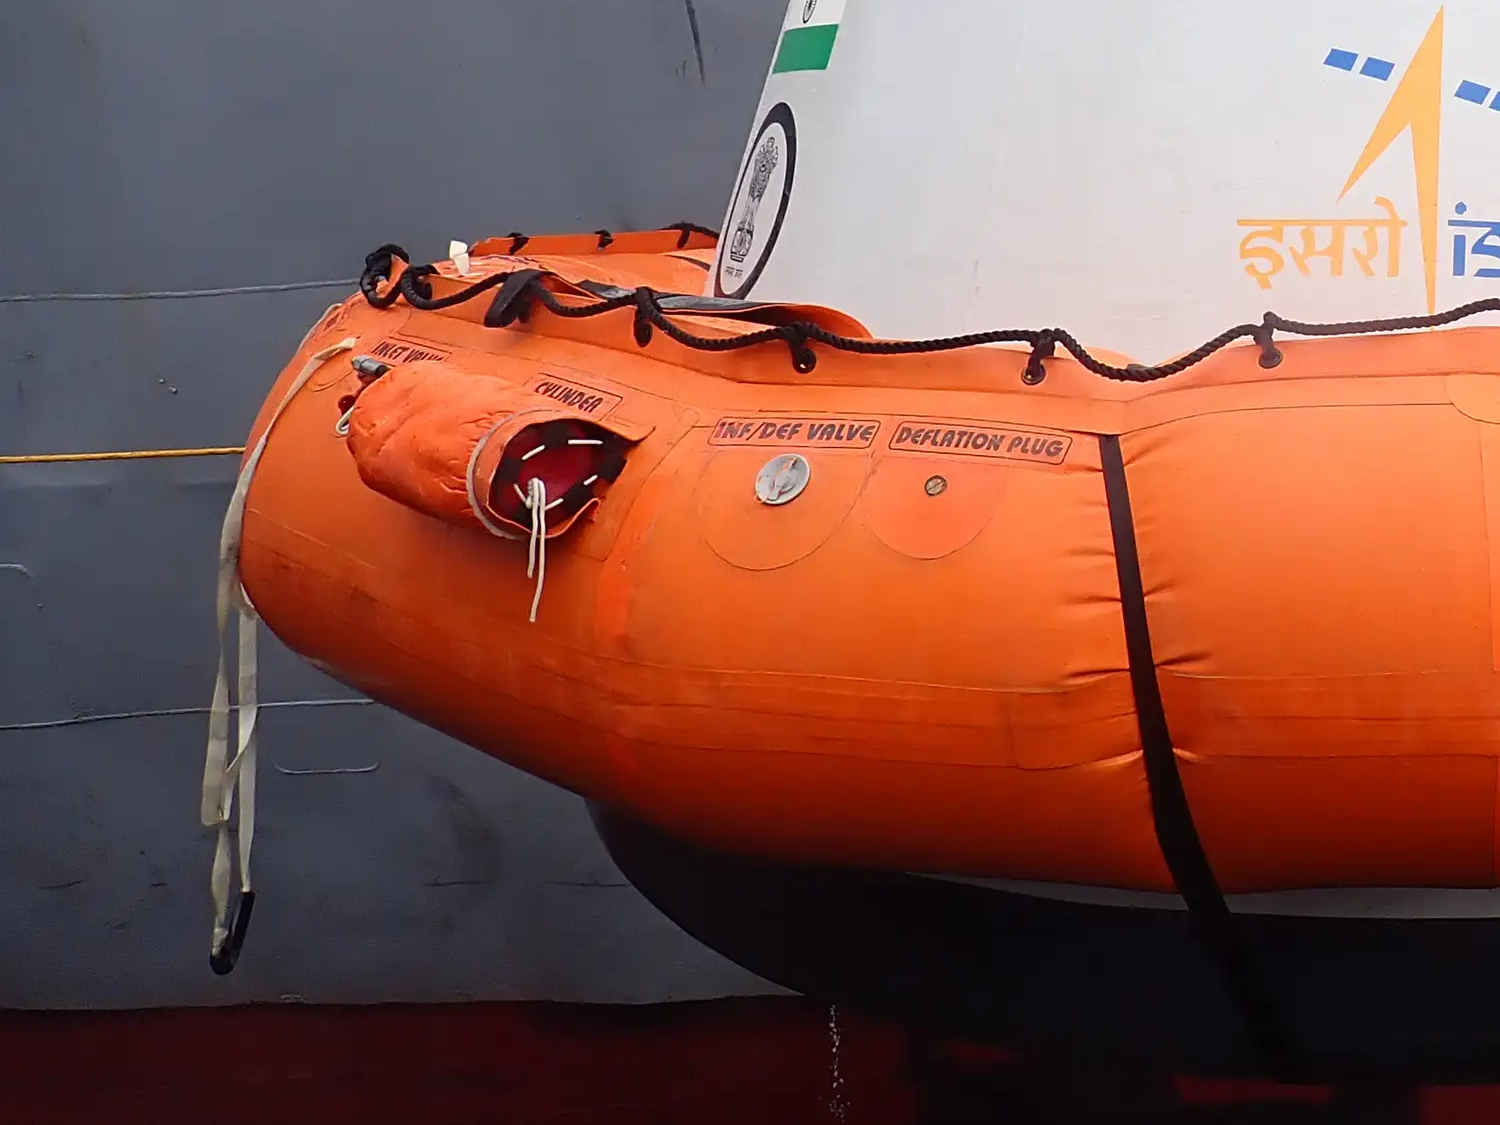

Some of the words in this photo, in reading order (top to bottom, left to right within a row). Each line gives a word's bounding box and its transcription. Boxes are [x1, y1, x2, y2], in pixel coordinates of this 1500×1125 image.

[1236, 195, 1409, 291] इसरो
[370, 340, 410, 361] INLET
[533, 381, 604, 413] CYLINDER
[713, 420, 803, 442] INF/DEF
[807, 423, 875, 442] VALVE
[895, 426, 1006, 452] DEFLATION
[1006, 435, 1064, 457] PLUG
